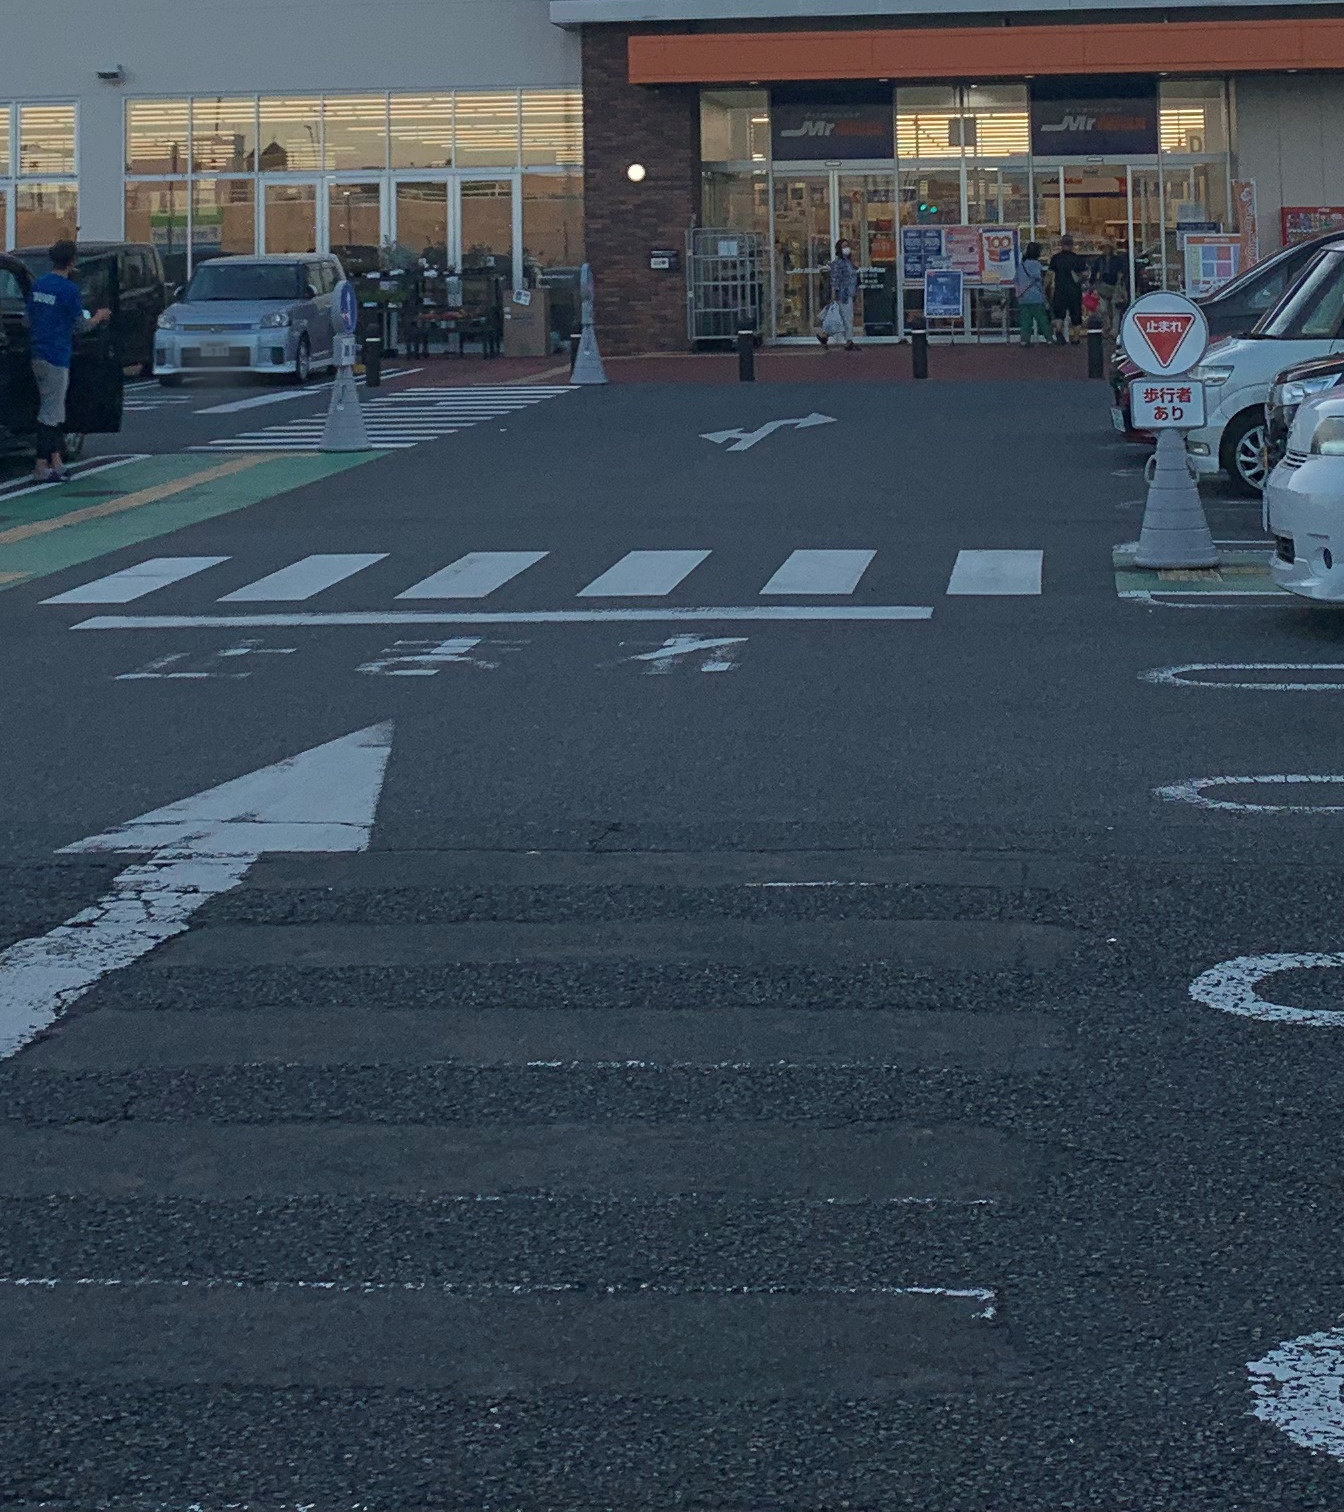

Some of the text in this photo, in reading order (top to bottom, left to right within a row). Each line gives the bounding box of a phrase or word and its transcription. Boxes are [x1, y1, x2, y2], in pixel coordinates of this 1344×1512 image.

[1145, 320, 1183, 334] 止まれ
[1143, 387, 1192, 404] 歩行者
[1153, 406, 1184, 421] あり
